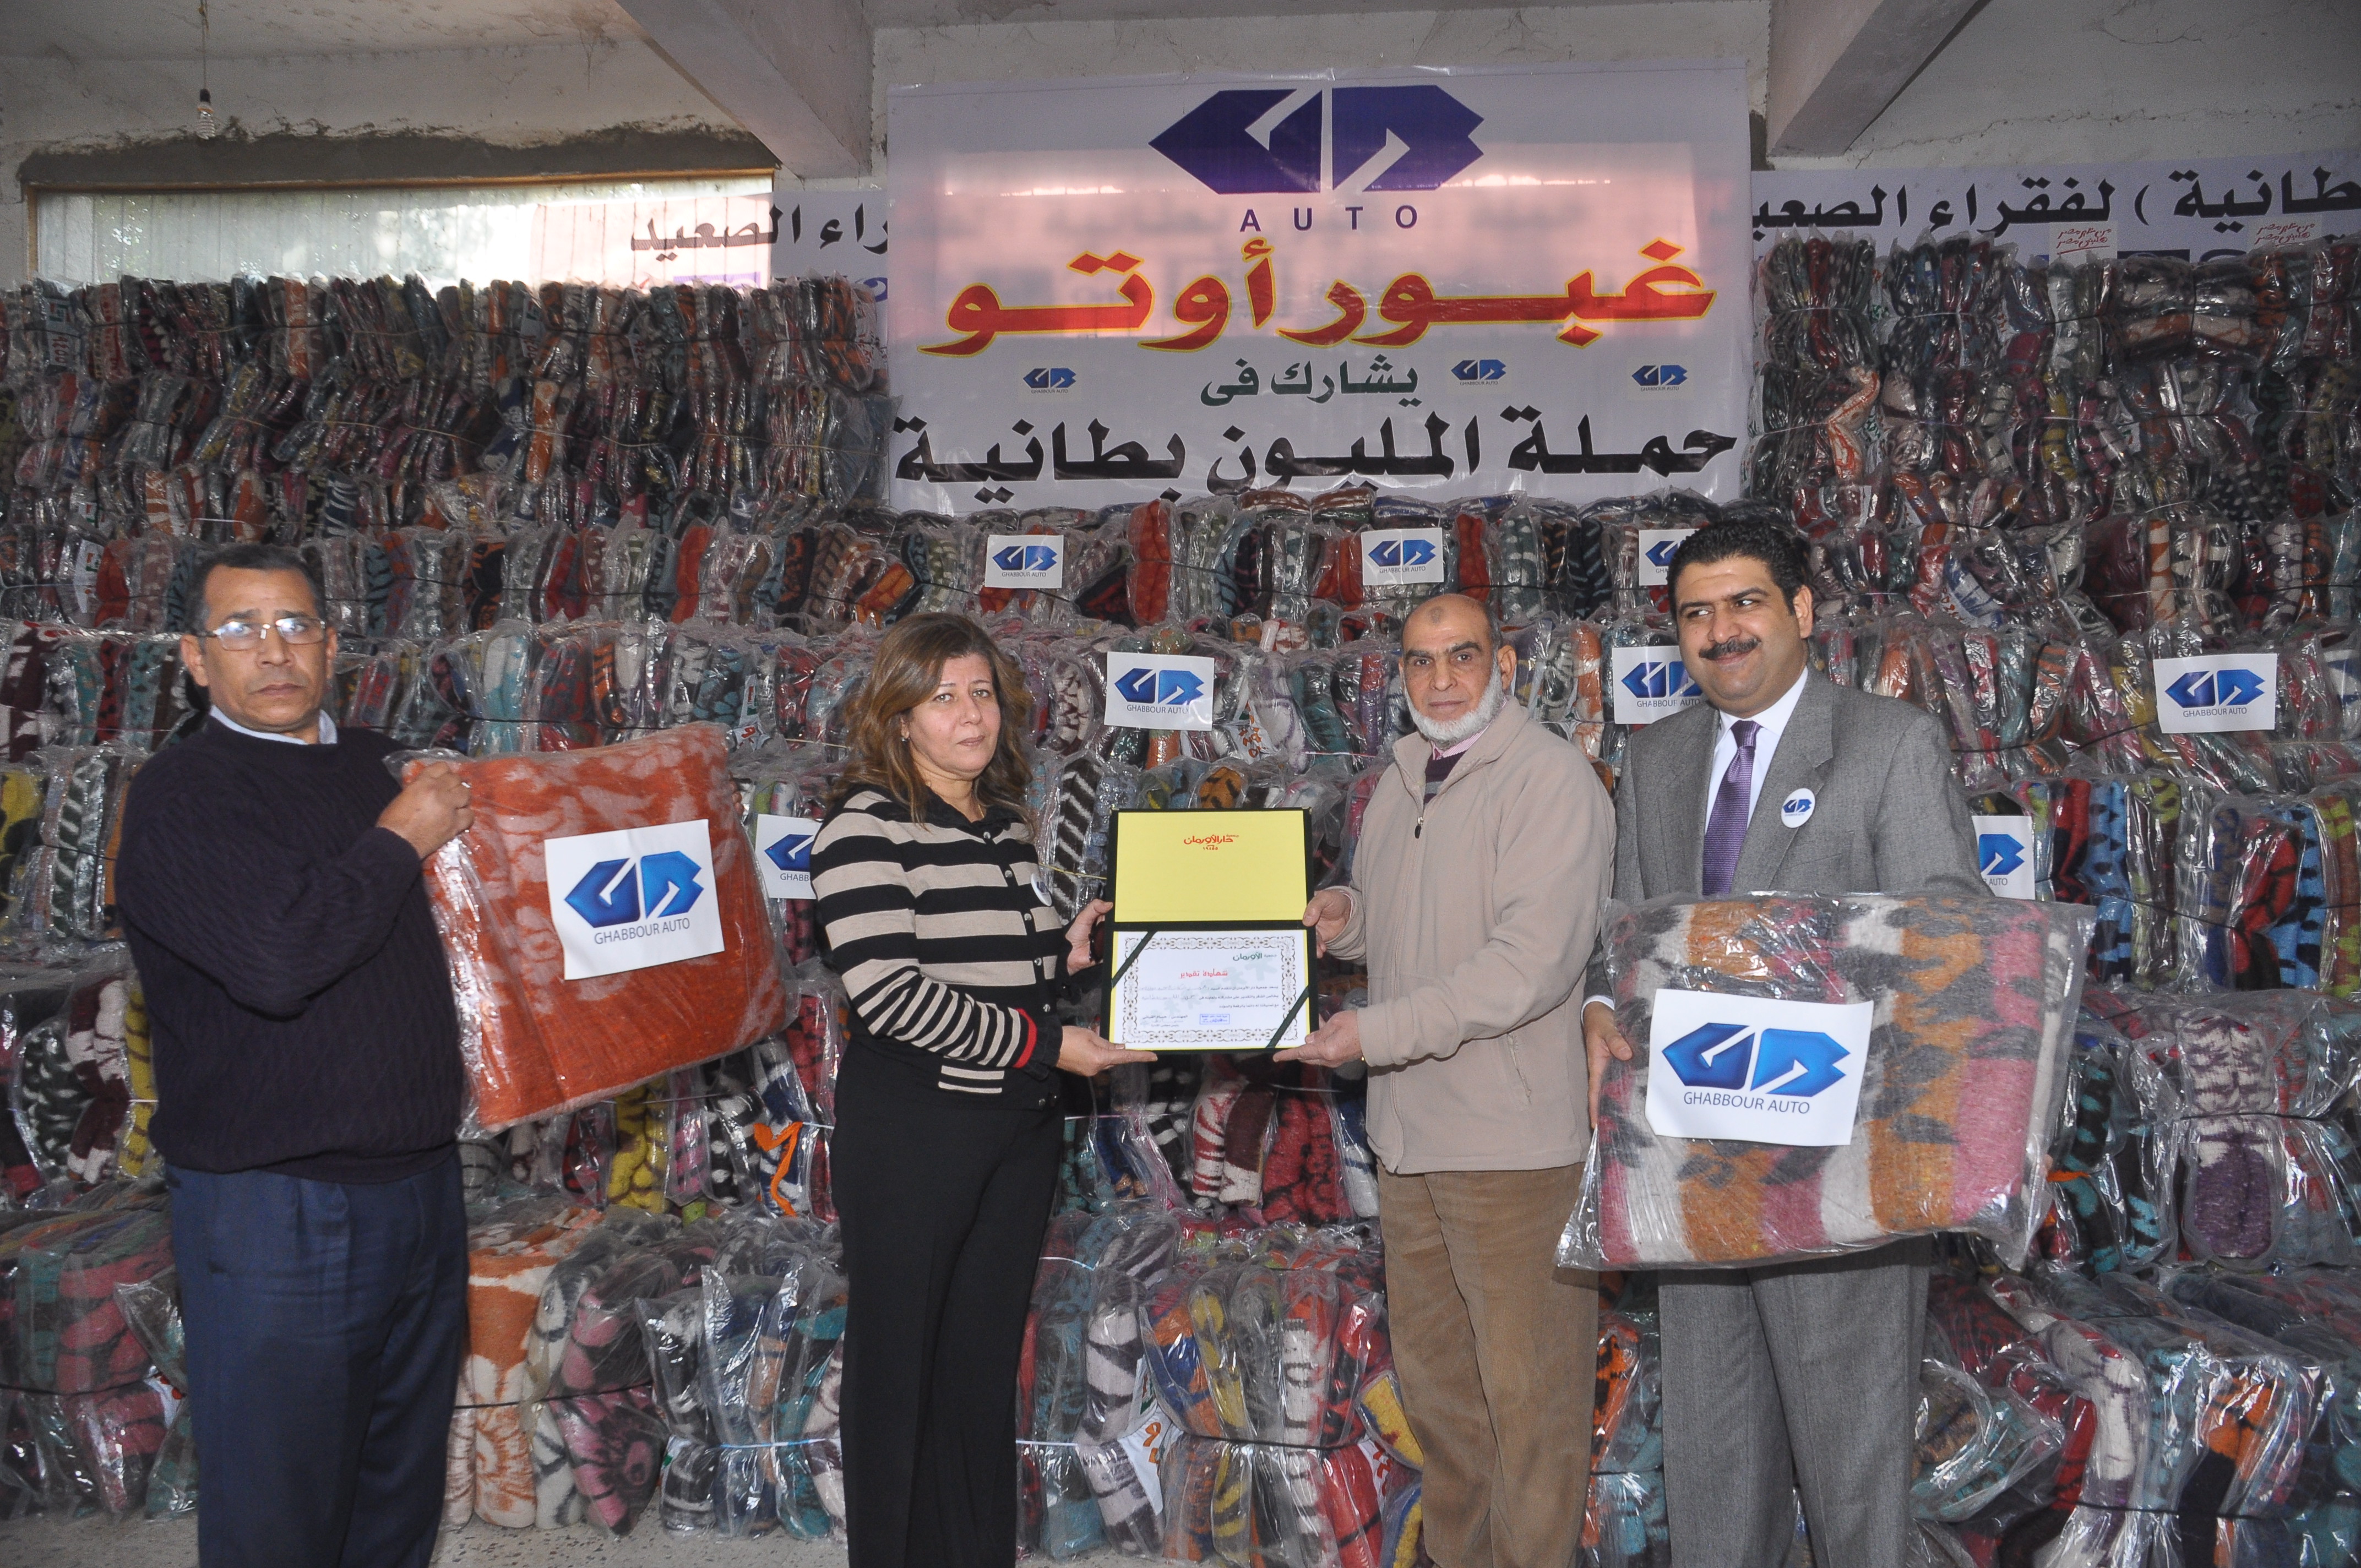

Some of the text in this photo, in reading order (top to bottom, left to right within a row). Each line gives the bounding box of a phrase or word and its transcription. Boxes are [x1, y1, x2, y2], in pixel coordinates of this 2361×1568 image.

[1239, 204, 1418, 233] AUTO
[1753, 183, 1907, 242] الصعي
[917, 236, 1718, 357] غبور أوتو
[1270, 354, 1423, 407] يشارك
[894, 405, 1738, 504] حملة المليون بطانية
[1127, 704, 1166, 714] GHABBOUR
[2183, 708, 2227, 718] GHABBOUR
[780, 873, 809, 881] GHABB
[1989, 878, 2008, 886] AUTO
[594, 917, 690, 944] GHABBOUR AUTO
[1683, 1091, 1810, 1114] GHABBOUR AUTO
